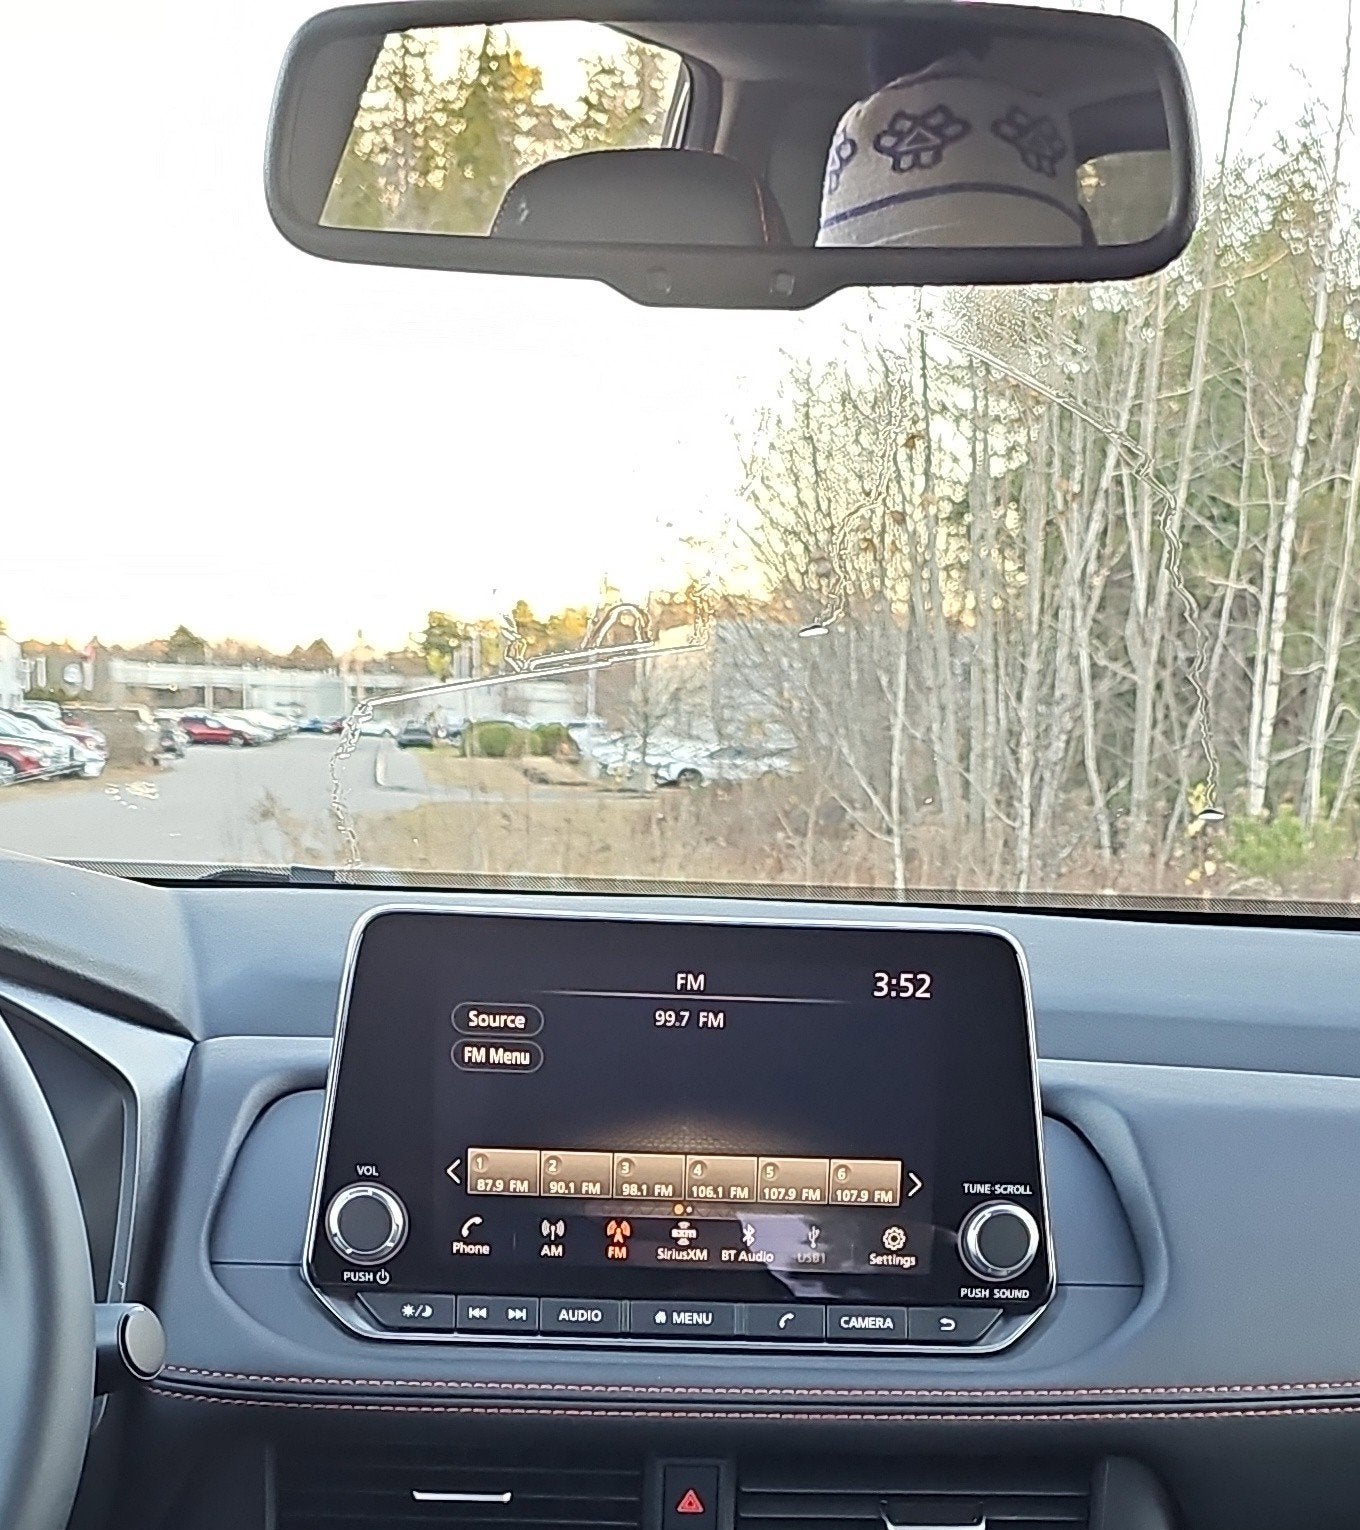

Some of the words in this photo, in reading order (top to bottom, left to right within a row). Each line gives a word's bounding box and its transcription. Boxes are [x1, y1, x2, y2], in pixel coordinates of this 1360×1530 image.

[676, 973, 705, 991] FM
[873, 972, 931, 999] 3:52
[468, 1010, 526, 1029] Source
[654, 1010, 690, 1027] 99.7
[698, 1012, 724, 1028] FM
[464, 1046, 486, 1063] FM
[490, 1048, 530, 1065] Menu
[356, 1165, 379, 1176] VOL
[476, 1158, 484, 1169] 1
[548, 1160, 557, 1172] 2
[621, 1162, 630, 1174] 3
[693, 1163, 702, 1176] 4
[766, 1166, 774, 1178] 5
[837, 1168, 846, 1180] 6
[476, 1179, 504, 1192] 87.9
[509, 1179, 529, 1193] FM
[549, 1181, 575, 1194] 90.1
[582, 1182, 601, 1195] FM
[622, 1183, 647, 1196] 98.1
[654, 1184, 673, 1197] FM
[691, 1185, 723, 1198] 106.1
[730, 1186, 749, 1199] FM
[763, 1187, 796, 1200] 107.9
[802, 1188, 821, 1201] FM
[835, 1189, 868, 1202] 107.9
[874, 1190, 893, 1203] FM
[452, 1241, 490, 1255] Phone
[540, 1244, 563, 1257] AM
[607, 1246, 627, 1259] FM
[657, 1247, 708, 1261] SiriusXM
[721, 1249, 737, 1261] BT
[738, 1250, 774, 1263] Audio
[869, 1252, 916, 1268] Settings
[343, 1272, 373, 1282] PUSH
[960, 1288, 989, 1298] PUSH
[993, 1288, 1030, 1298] SOUND
[558, 1308, 602, 1322] AUDIO
[672, 1312, 713, 1325] MENU
[840, 1316, 893, 1330] CAMERA
